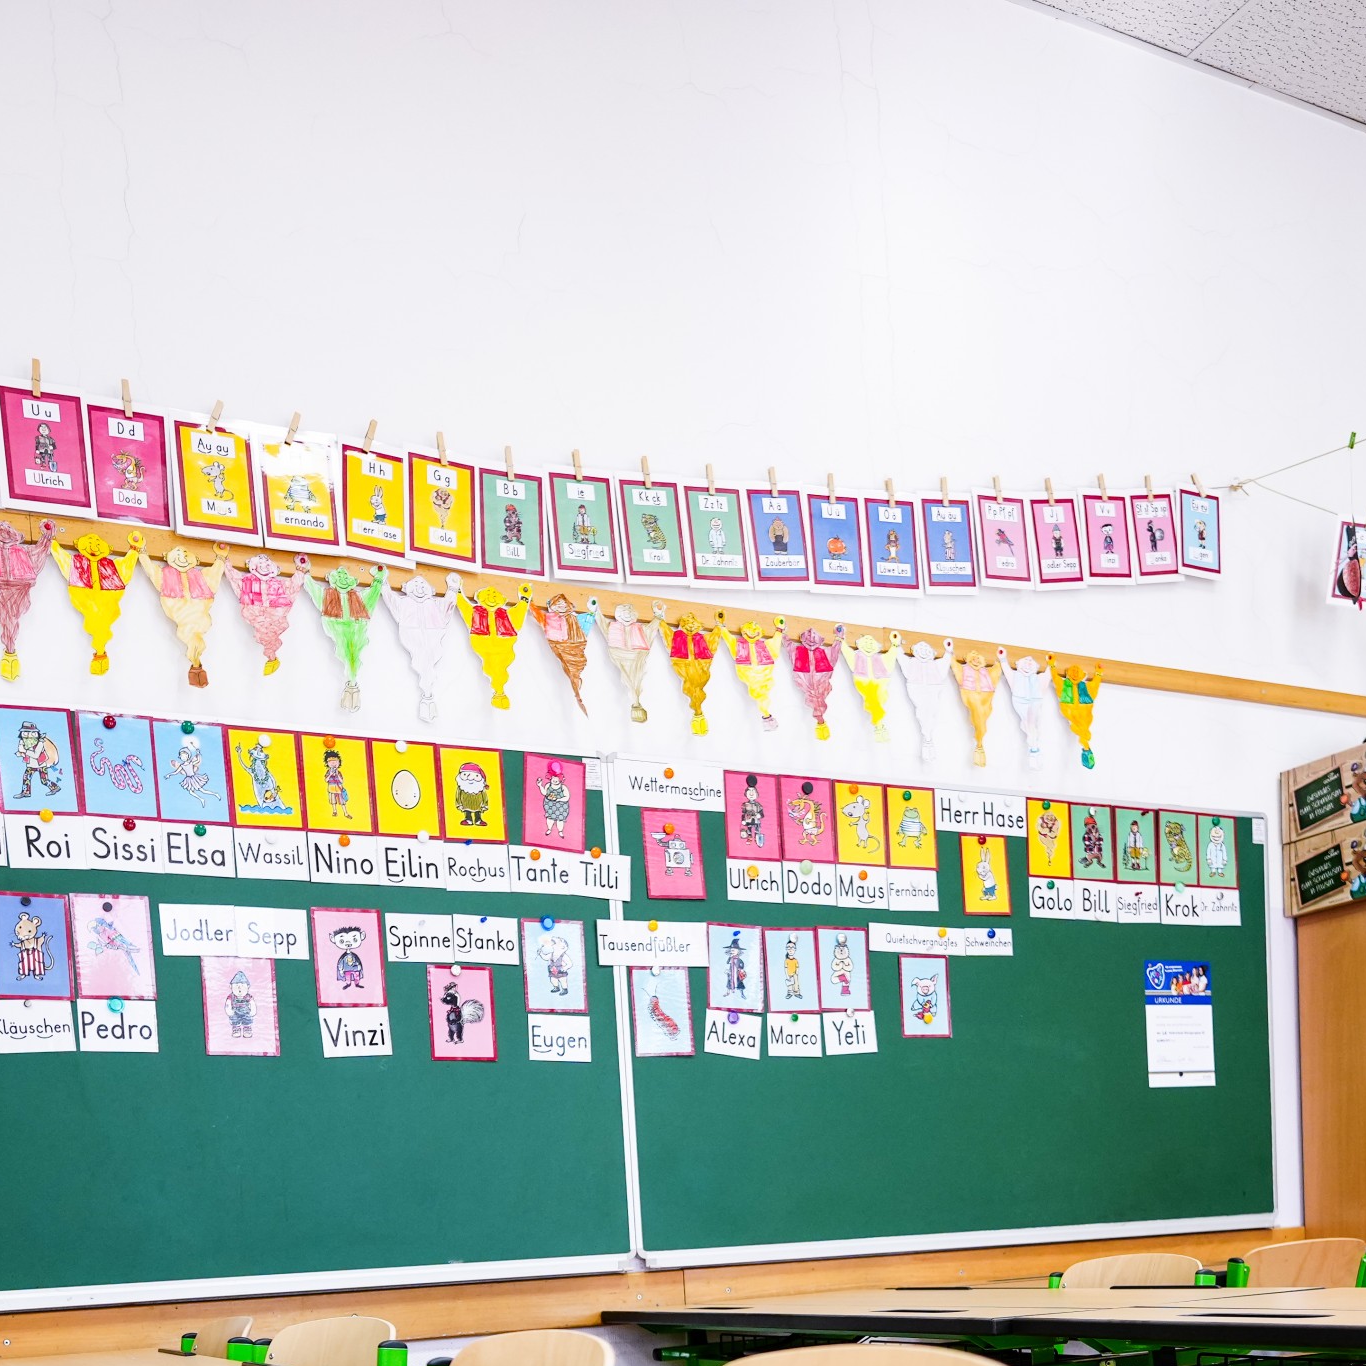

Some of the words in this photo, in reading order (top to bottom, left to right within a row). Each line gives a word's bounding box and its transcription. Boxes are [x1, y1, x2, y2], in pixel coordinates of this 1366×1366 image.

[32, 404, 40, 416] U
[45, 409, 52, 418] u
[117, 422, 125, 435] D
[128, 425, 135, 437] d
[33, 473, 64, 487] Ulrich
[369, 462, 376, 474] H
[379, 465, 385, 476] h
[433, 470, 441, 481] G
[445, 476, 450, 486] g
[118, 491, 143, 506] Dodo
[503, 484, 510, 494] B
[512, 485, 518, 496] b
[577, 487, 585, 497] ie
[1000, 559, 1014, 567] edro
[1045, 560, 1061, 569] odler
[628, 775, 722, 798] Wettermaschine
[940, 798, 979, 826] Herr
[983, 802, 1024, 830] Hase
[25, 825, 71, 858] Roi
[92, 826, 156, 863] Sissi
[166, 832, 226, 867] Elsa
[238, 842, 304, 866] Wassil
[314, 842, 373, 875] Nino
[385, 847, 439, 879] Eilin
[448, 858, 505, 878] Rochus
[511, 856, 569, 883] Tante
[580, 861, 619, 889] Tilli
[729, 868, 780, 893] Ulrich
[787, 870, 833, 896] Dodo
[839, 875, 884, 899] Maus
[889, 882, 935, 898] Fernando
[1032, 885, 1073, 912] Golo
[1082, 889, 1111, 914] Bill
[1117, 897, 1158, 915] Siegfried
[1165, 894, 1199, 917] Krok
[166, 918, 233, 942] Jodler
[248, 921, 297, 954] Sepp
[389, 925, 451, 958] Spinne
[456, 927, 515, 952] Stanko
[599, 934, 691, 958] Tausendfüßler
[965, 937, 1011, 947] Schweinchen
[81, 1011, 152, 1040] Pedro
[324, 1017, 385, 1047] Vinzi
[707, 1019, 756, 1048] Alexa
[770, 1025, 818, 1046] Marco
[832, 1019, 866, 1046] Yeti
[531, 1025, 587, 1056] Eugen
